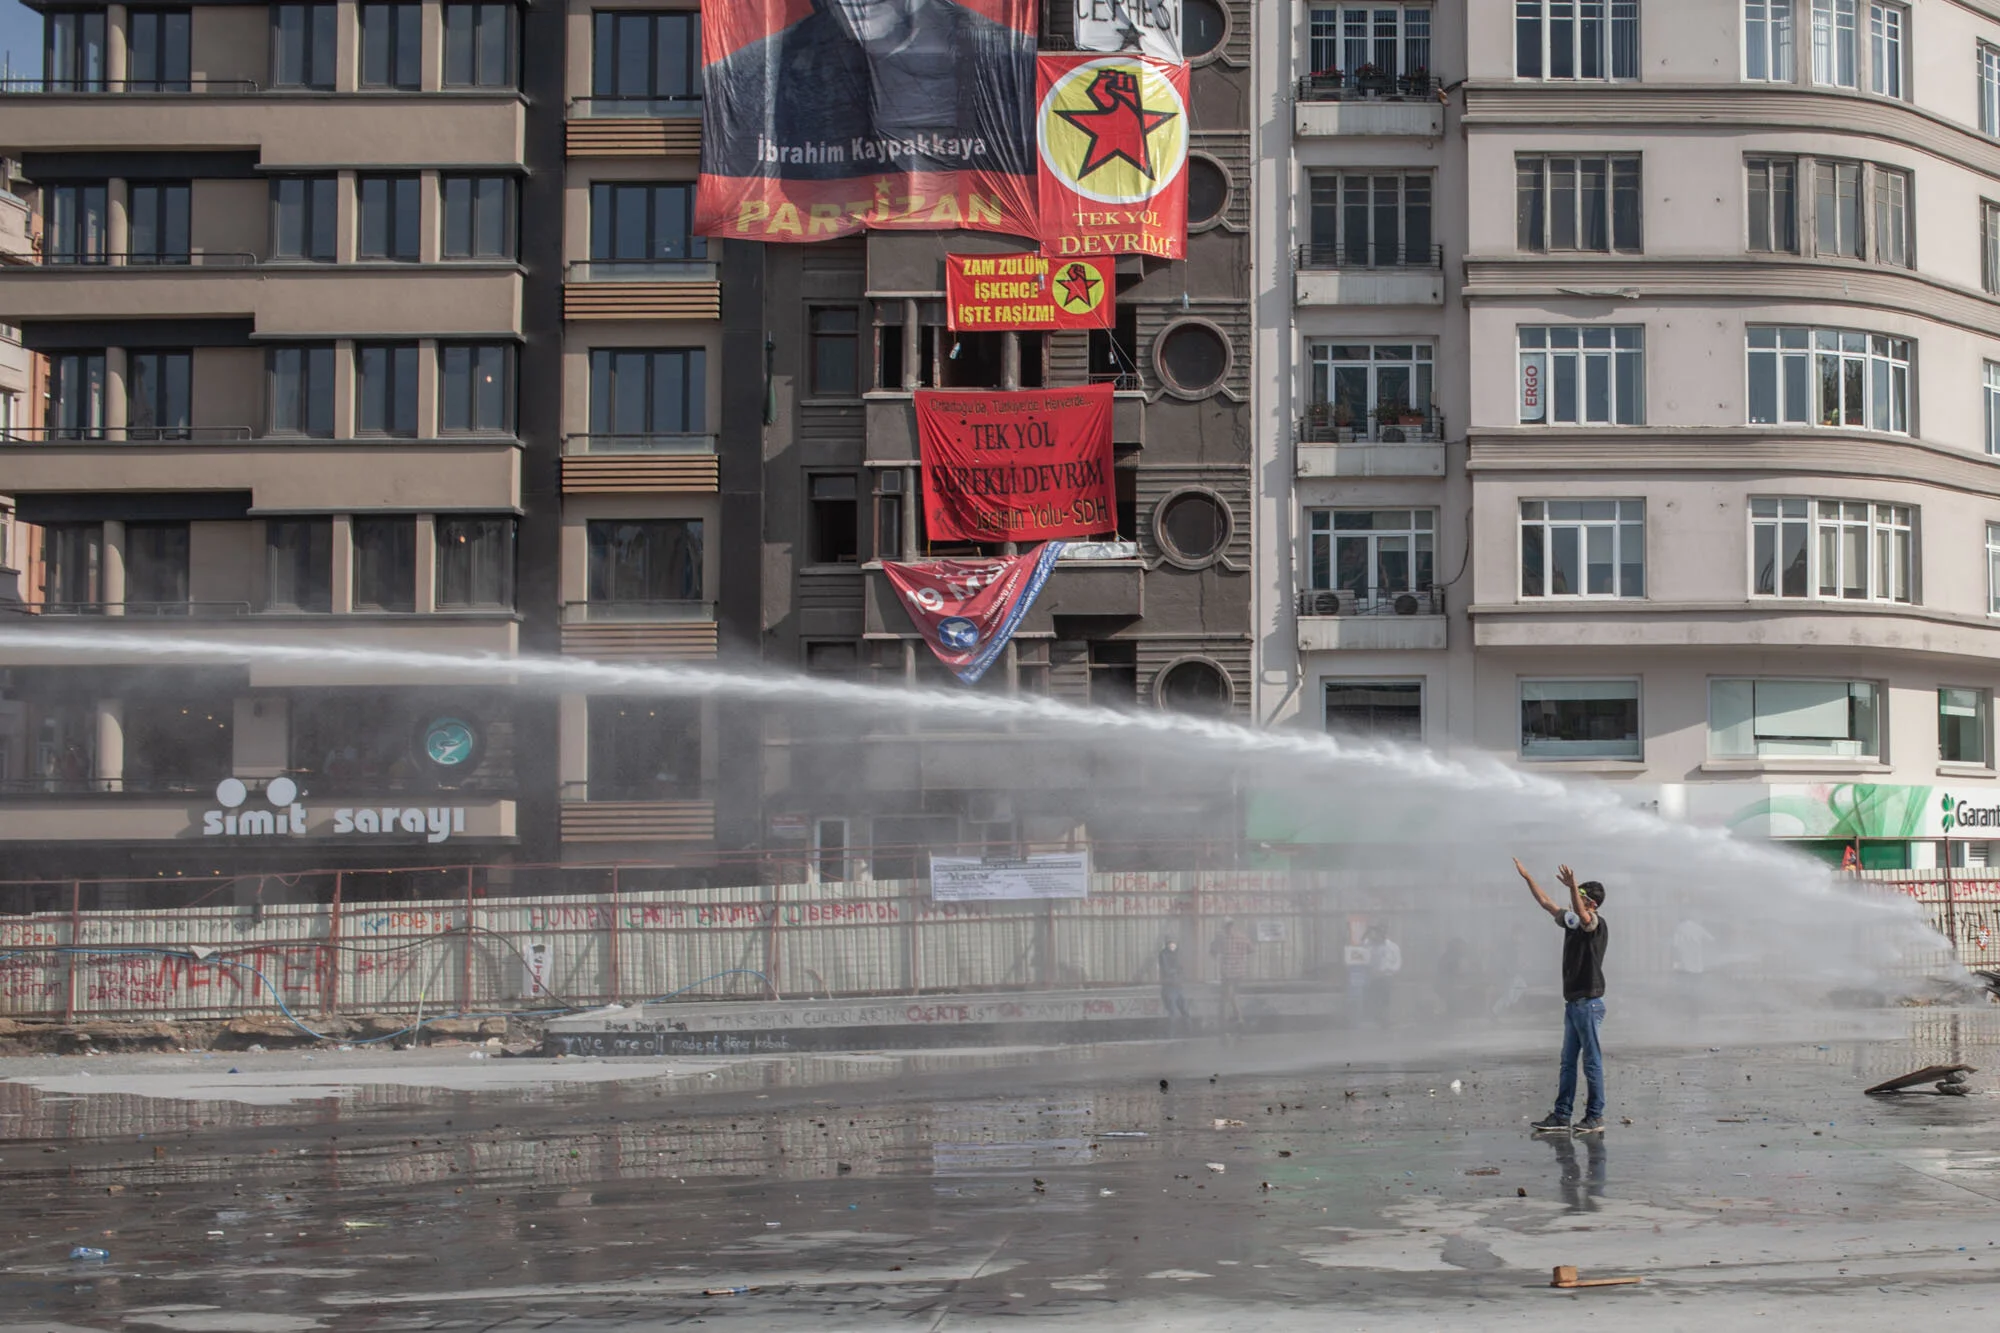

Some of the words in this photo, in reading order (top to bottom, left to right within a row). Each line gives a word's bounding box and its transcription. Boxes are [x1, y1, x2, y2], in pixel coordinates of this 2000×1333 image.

[758, 133, 844, 164] İbrahim
[852, 133, 987, 163] Kaypakkaya
[736, 190, 1004, 235] PARTİZAN
[1072, 211, 1121, 226] TEK
[1124, 209, 1162, 227] YOL
[1058, 230, 1170, 256] DEVRİM!
[963, 259, 995, 276] ZAM
[998, 255, 1049, 275] ZULÜM
[974, 280, 1039, 302] İŞKENCE
[959, 303, 992, 326] İŞTE
[995, 302, 1055, 326] FAŞİZM!
[1525, 365, 1538, 407] ERGO
[971, 423, 1009, 451] TEK
[1013, 421, 1056, 449] YOL
[932, 459, 1018, 496] SÜREKLİ
[1022, 455, 1105, 493] DEVRİM
[1071, 496, 1108, 525] SDH
[906, 587, 945, 616] 19
[204, 779, 306, 835] simit
[613, 1039, 641, 1051] are
[643, 1034, 664, 1052] all
